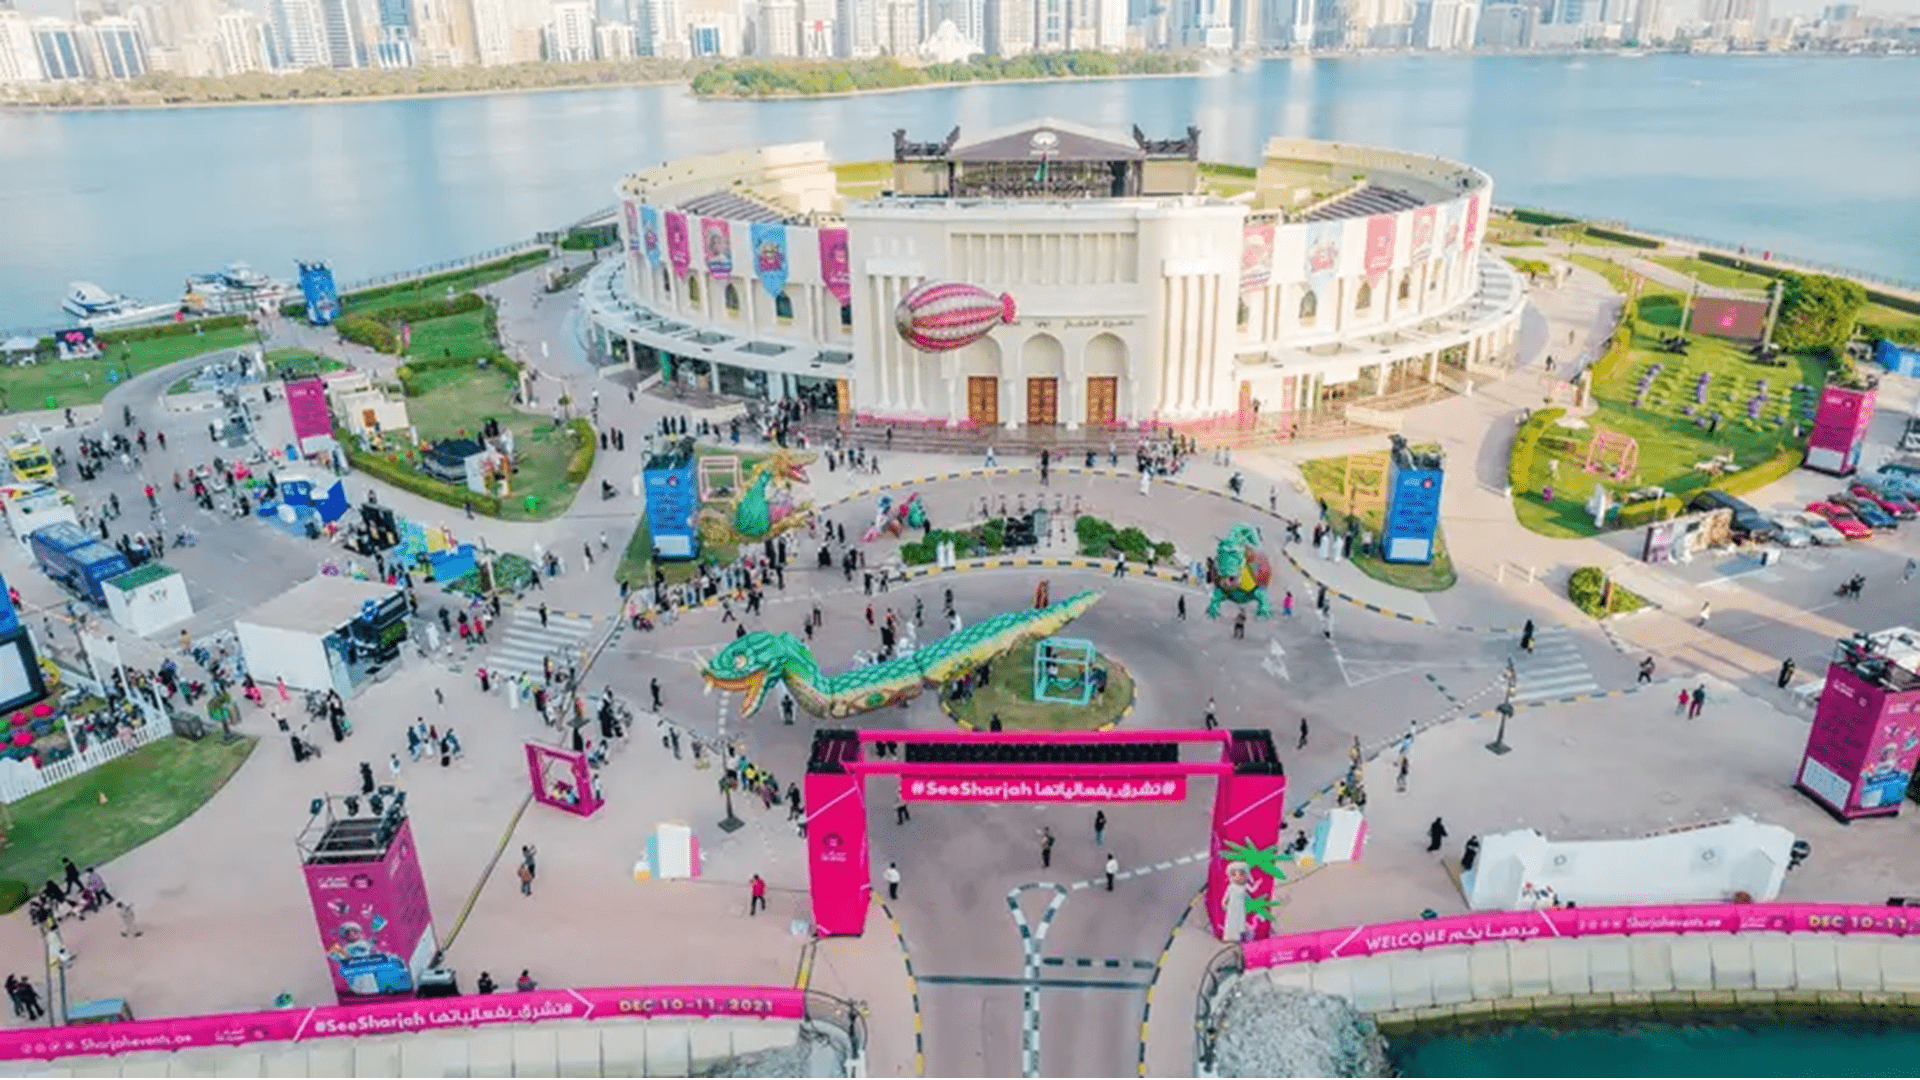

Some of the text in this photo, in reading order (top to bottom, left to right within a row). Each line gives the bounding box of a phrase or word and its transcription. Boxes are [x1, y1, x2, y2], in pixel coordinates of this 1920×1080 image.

[911, 780, 1032, 799] #SeeSharjah
[1808, 915, 1844, 928] DEC
[1366, 929, 1446, 949] WELCOME
[619, 999, 655, 1011] DEC
[315, 1011, 426, 1032] #SeeSharjah
